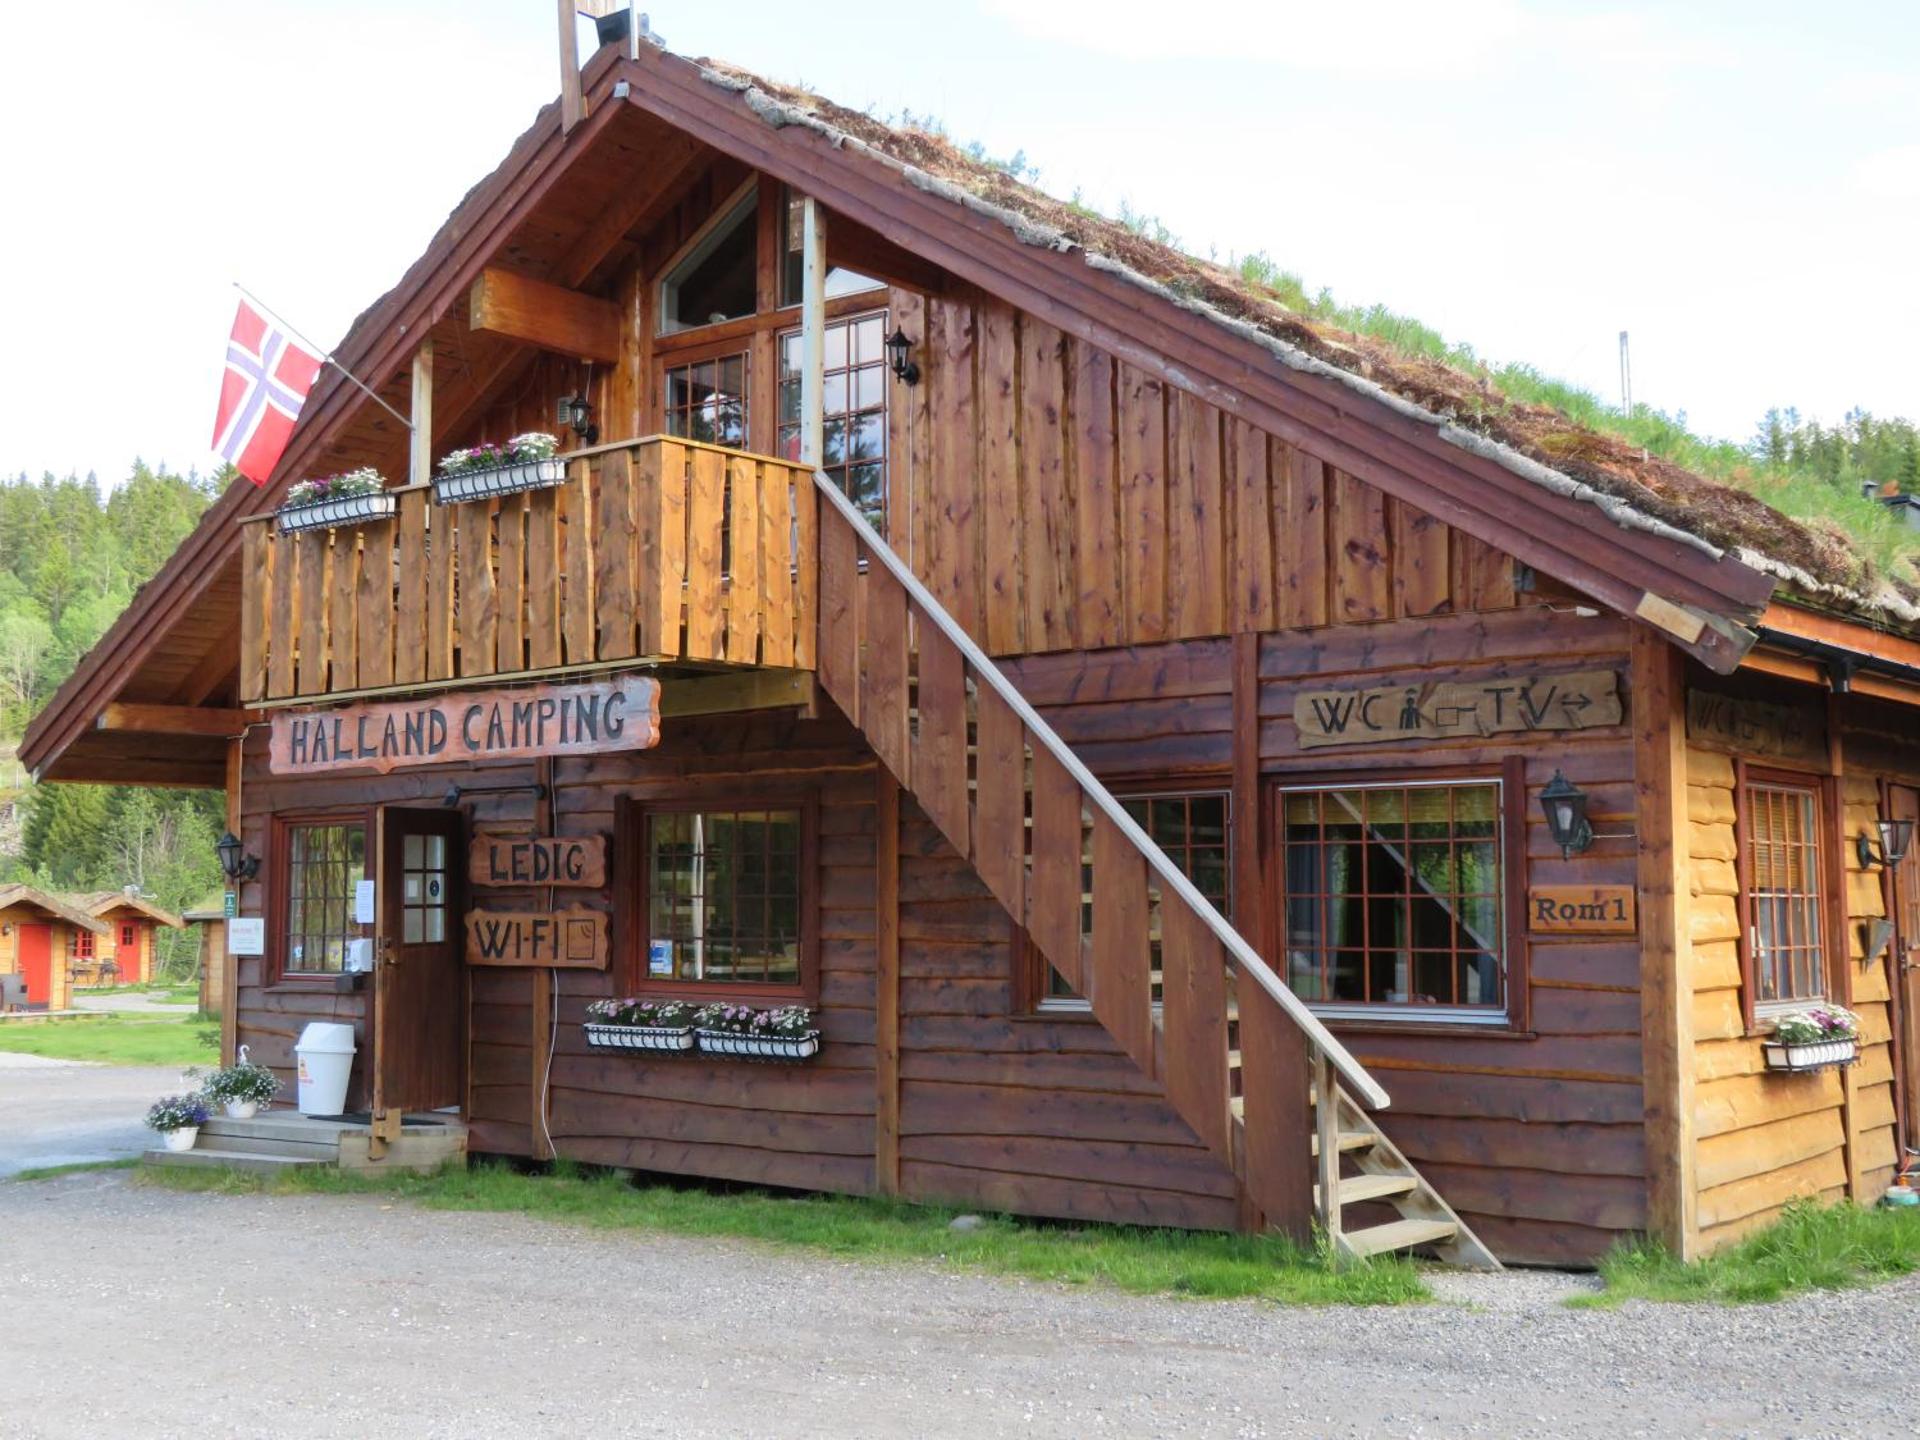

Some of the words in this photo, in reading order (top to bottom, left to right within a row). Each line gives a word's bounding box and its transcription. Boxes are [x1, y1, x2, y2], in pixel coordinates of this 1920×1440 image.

[290, 707, 448, 765] HALLAND
[462, 691, 627, 752] CAMPING
[1311, 694, 1383, 733] WC
[1483, 685, 1557, 725] TV
[489, 843, 583, 881] LEDIG
[1535, 898, 1607, 921] Rom
[1612, 898, 1628, 921] 1
[474, 919, 560, 960] WI-FI
